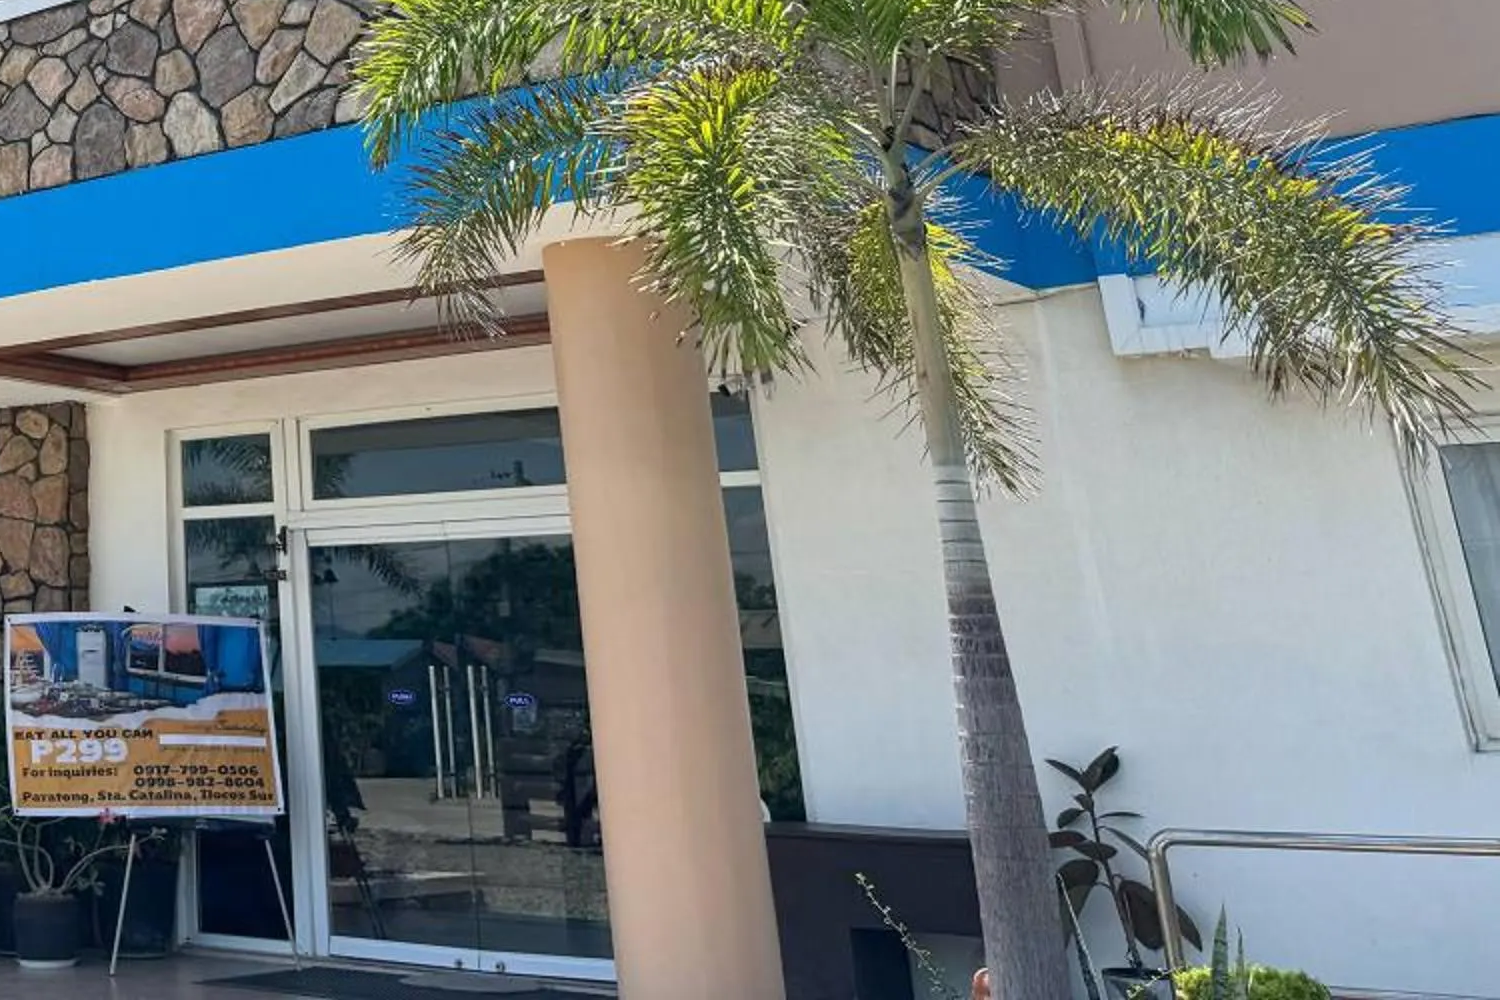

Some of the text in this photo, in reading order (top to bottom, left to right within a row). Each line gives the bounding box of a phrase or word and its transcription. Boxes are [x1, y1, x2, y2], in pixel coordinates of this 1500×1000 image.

[51, 729, 77, 739] ALL
[83, 729, 117, 739] YOU
[121, 729, 153, 739] CAN
[200, 789, 245, 799] Ilocos
